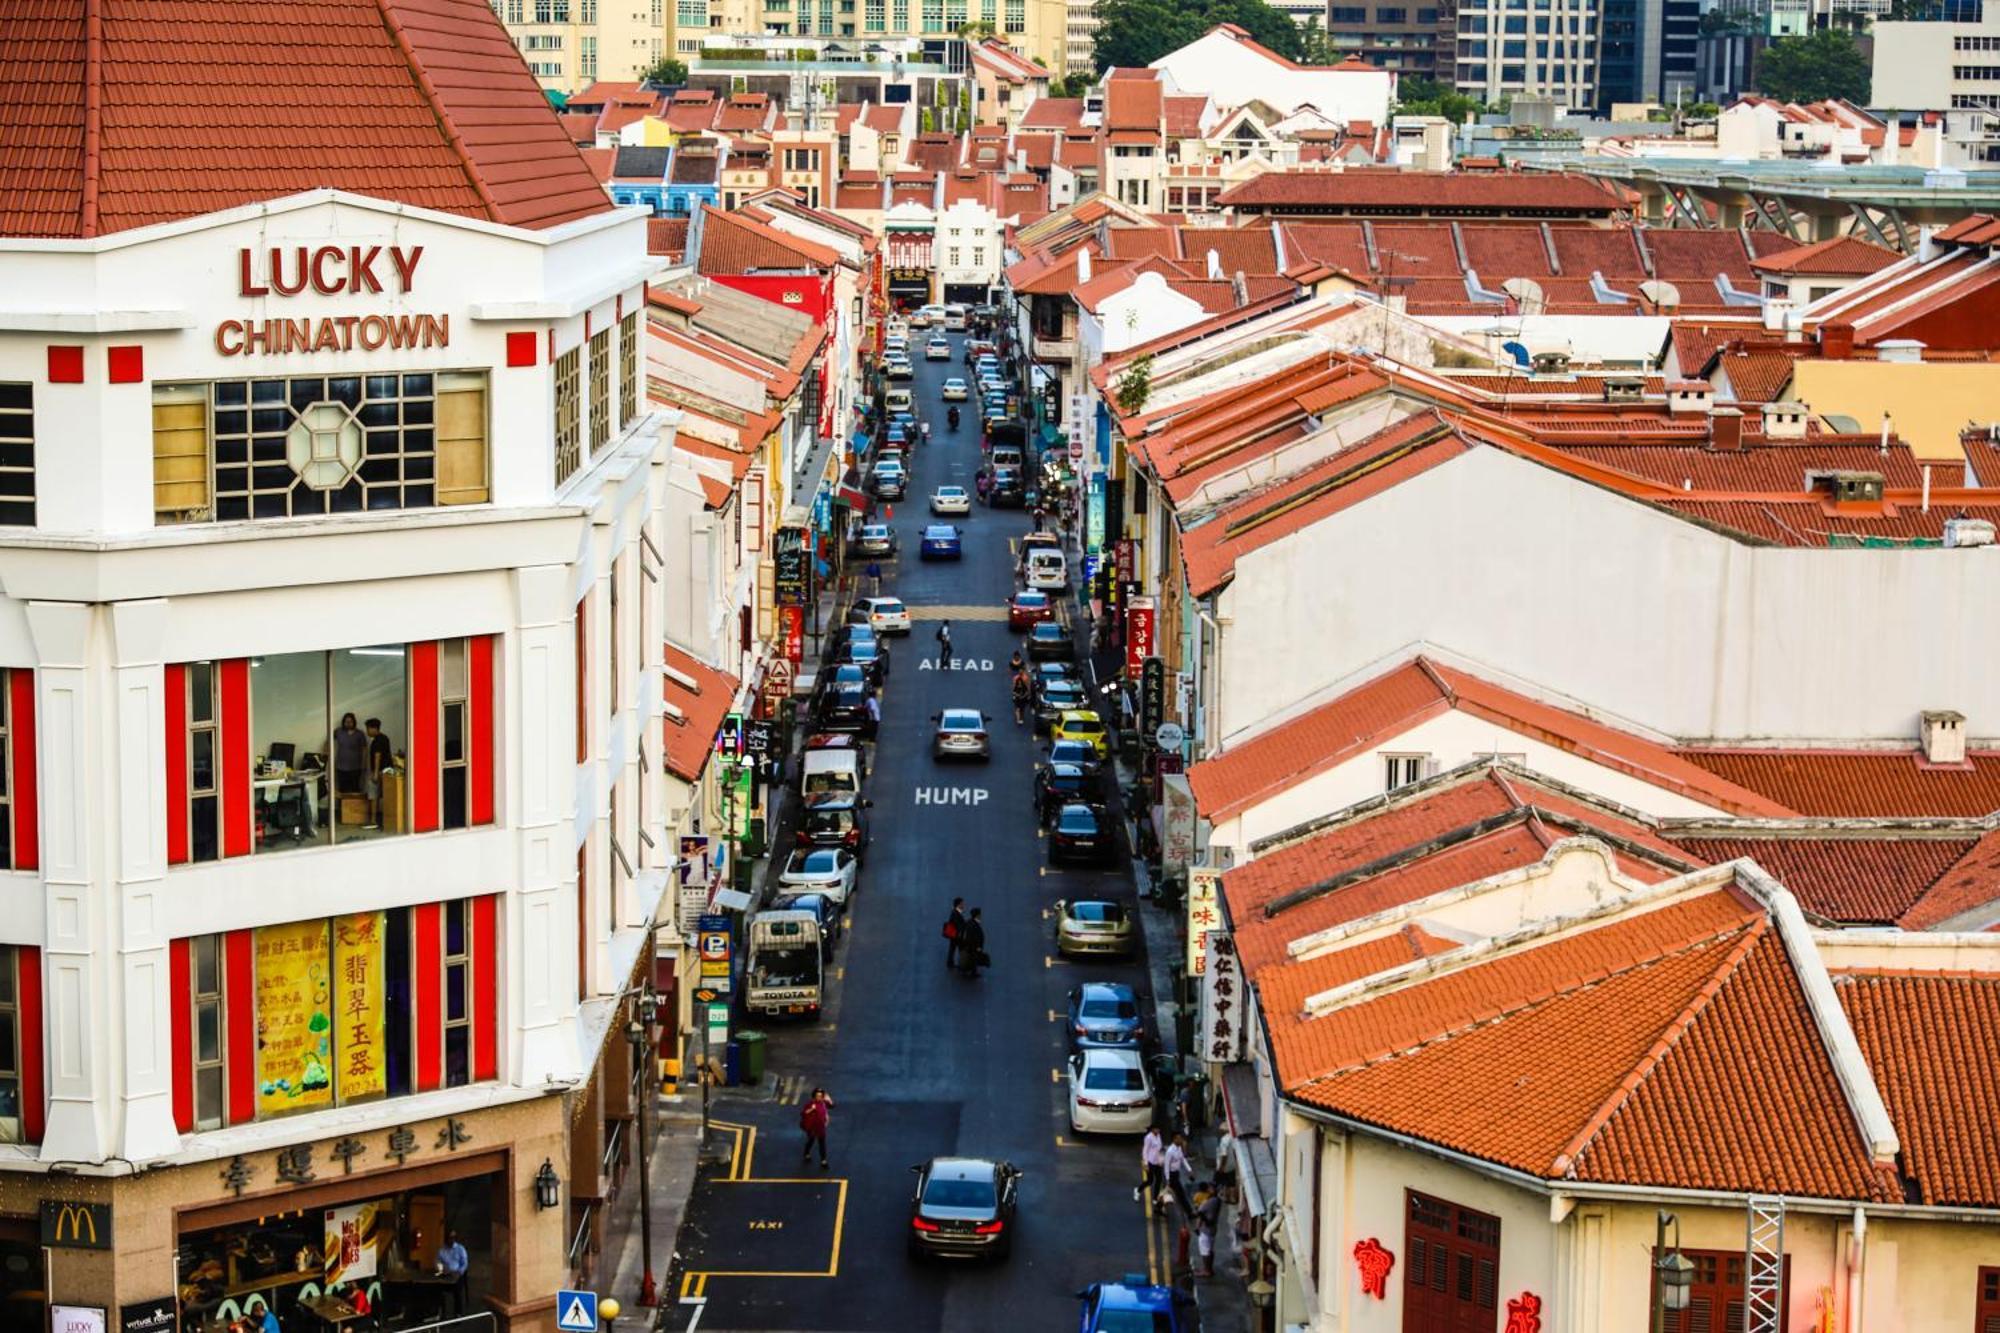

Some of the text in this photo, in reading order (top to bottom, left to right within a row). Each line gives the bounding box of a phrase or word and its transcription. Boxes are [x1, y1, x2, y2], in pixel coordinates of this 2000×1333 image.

[239, 245, 424, 298] LUCKY
[215, 314, 450, 356] CHINATOWN
[915, 787, 989, 806] HUMP
[764, 991, 805, 1000] TOYOTA
[345, 955, 375, 1077] 翡翠玉器
[749, 1220, 783, 1230] TAXI
